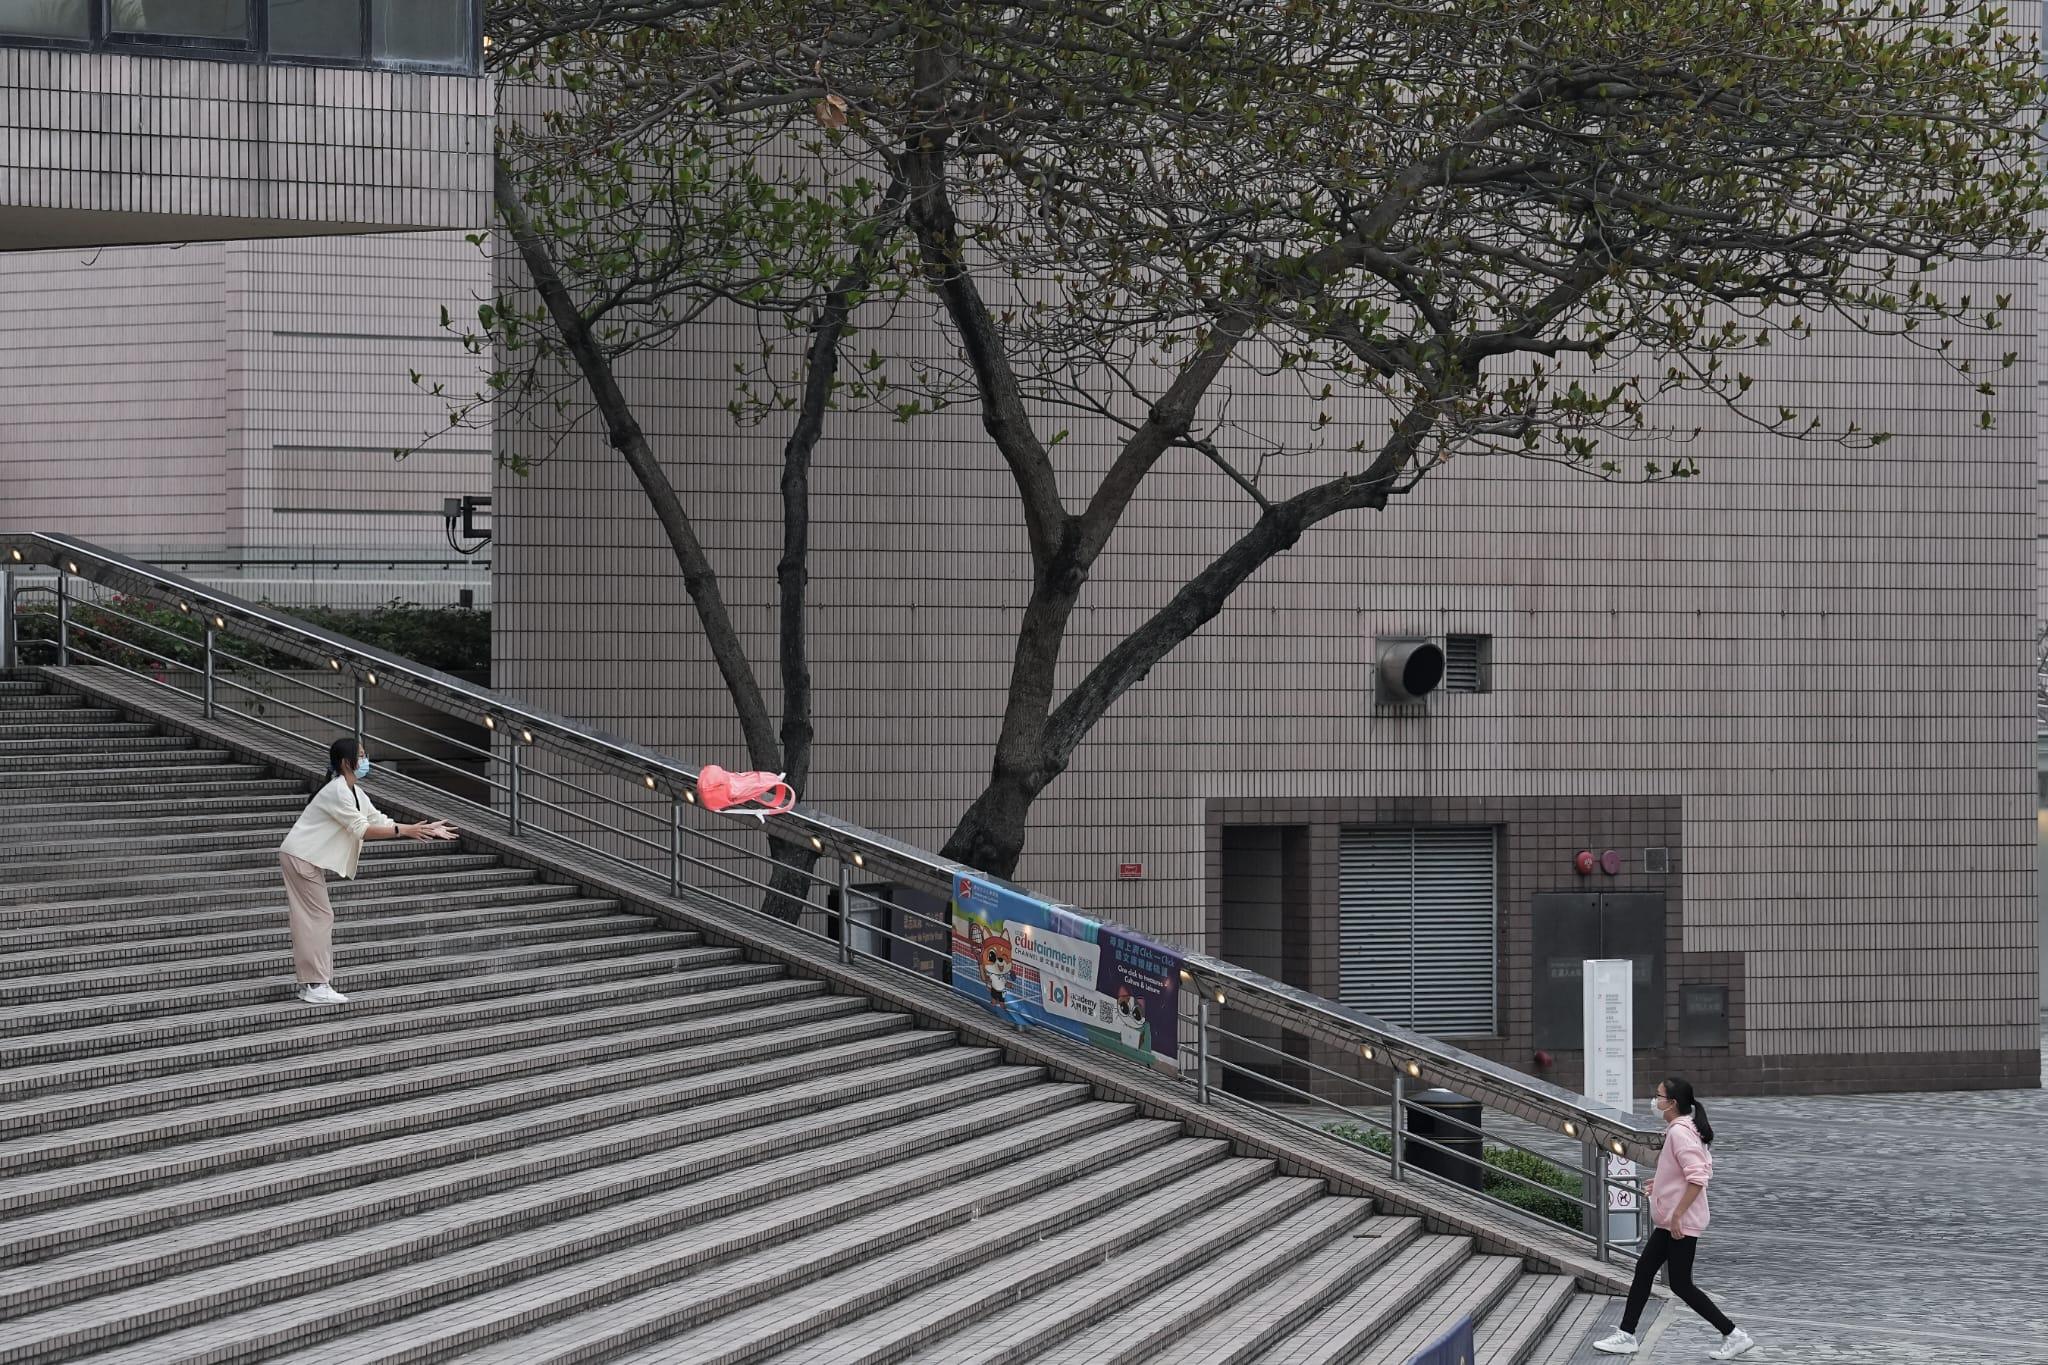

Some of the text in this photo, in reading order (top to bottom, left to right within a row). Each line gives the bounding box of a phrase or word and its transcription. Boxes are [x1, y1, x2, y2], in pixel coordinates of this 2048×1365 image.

[1014, 933, 1076, 967] edutainment
[1014, 947, 1038, 961] CHANNEL
[1117, 964, 1128, 974] One
[1128, 969, 1138, 978] click
[1124, 975, 1140, 987] Culture
[1145, 983, 1161, 995] Leisure
[1070, 992, 1097, 1010] academy
